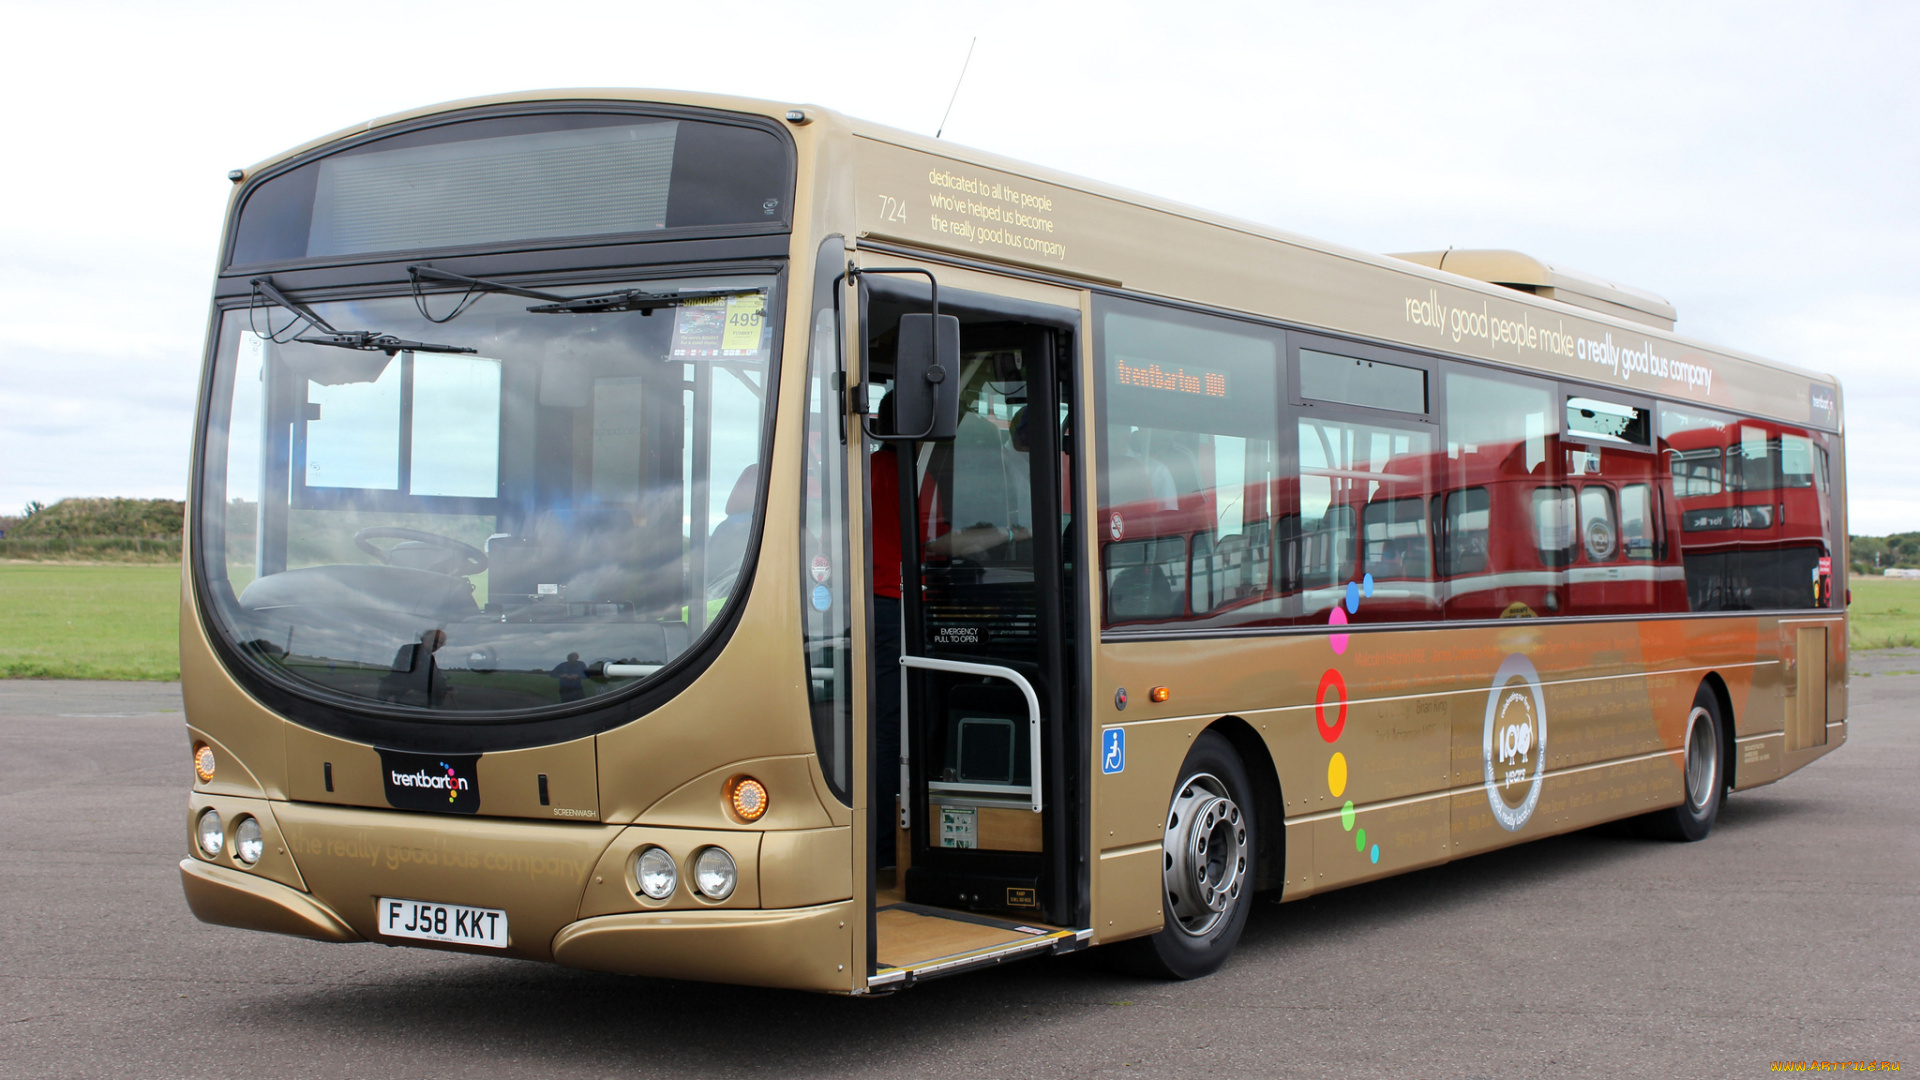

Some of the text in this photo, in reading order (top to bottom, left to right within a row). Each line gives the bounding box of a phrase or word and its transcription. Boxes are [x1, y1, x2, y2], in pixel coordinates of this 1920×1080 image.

[929, 168, 1052, 212] dedicated to all the people
[878, 194, 907, 224] 724
[930, 192, 1053, 233] who've helped us become
[931, 214, 1066, 260] the really good bus company
[729, 313, 759, 327] 499
[1405, 288, 1713, 395] really good people make a really good bus company
[1118, 359, 1200, 394] trentbarton
[934, 635, 979, 643] PULL TO OPEN
[940, 627, 979, 636] EMERGENCY
[391, 768, 468, 791] trentbarton
[1505, 768, 1526, 789] years
[553, 808, 597, 818] SCREENWASH
[291, 827, 589, 885] the really good bus company
[388, 902, 500, 941] FJ58 KKT
